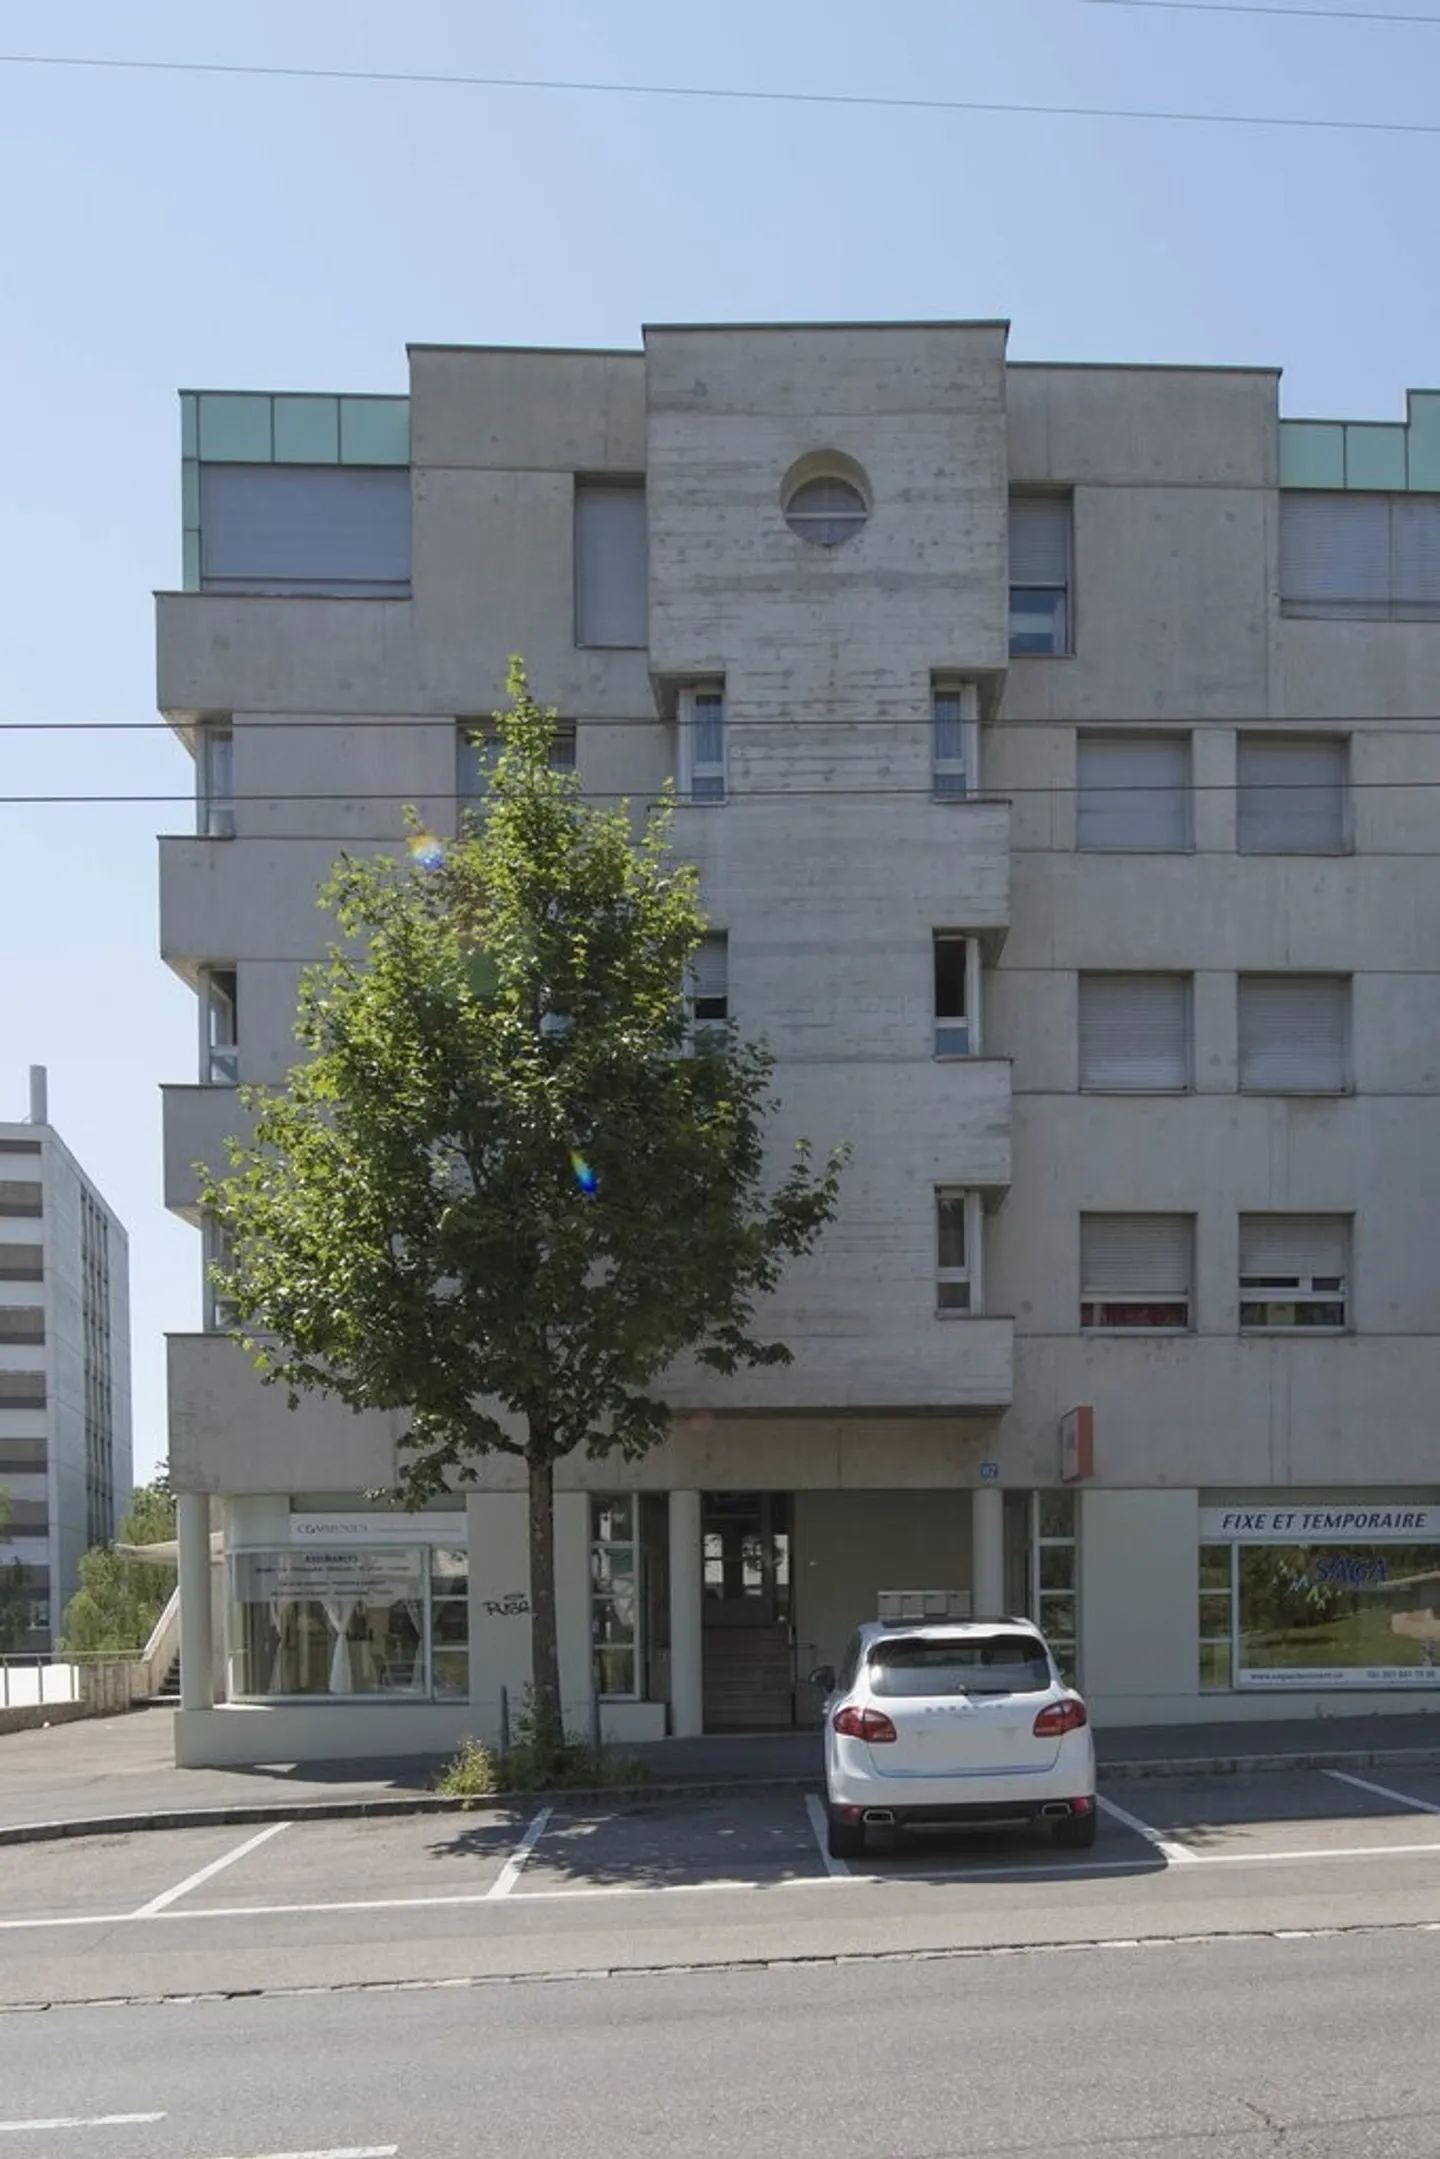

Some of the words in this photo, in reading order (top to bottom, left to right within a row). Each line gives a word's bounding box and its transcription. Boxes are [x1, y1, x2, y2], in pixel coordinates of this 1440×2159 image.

[1222, 1514, 1266, 1530] FIXE
[1272, 1514, 1297, 1530] ET
[1302, 1512, 1428, 1530] TEMPORAIRE
